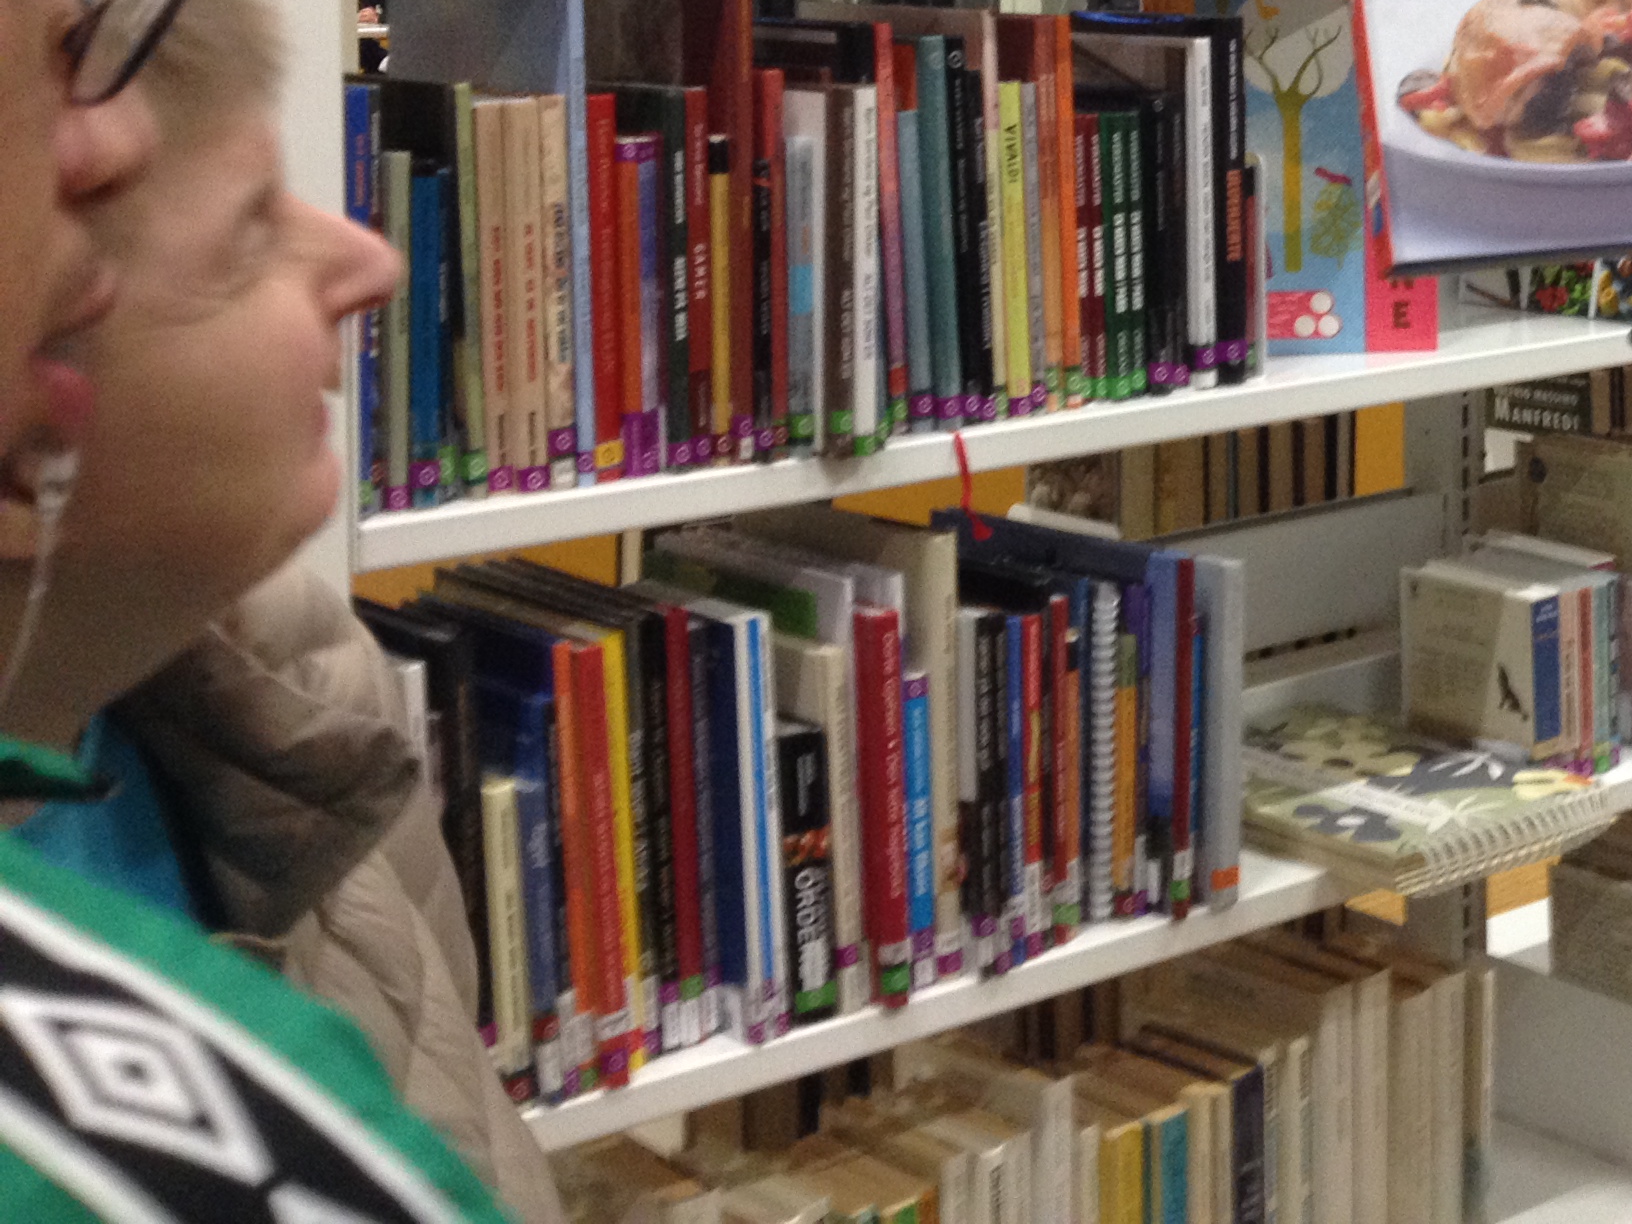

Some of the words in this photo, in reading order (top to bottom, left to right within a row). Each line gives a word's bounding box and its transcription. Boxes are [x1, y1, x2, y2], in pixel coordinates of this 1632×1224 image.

[1004, 124, 1019, 184] VIVALDI
[1393, 301, 1410, 329] E
[1494, 396, 1580, 431] MANFREDI
